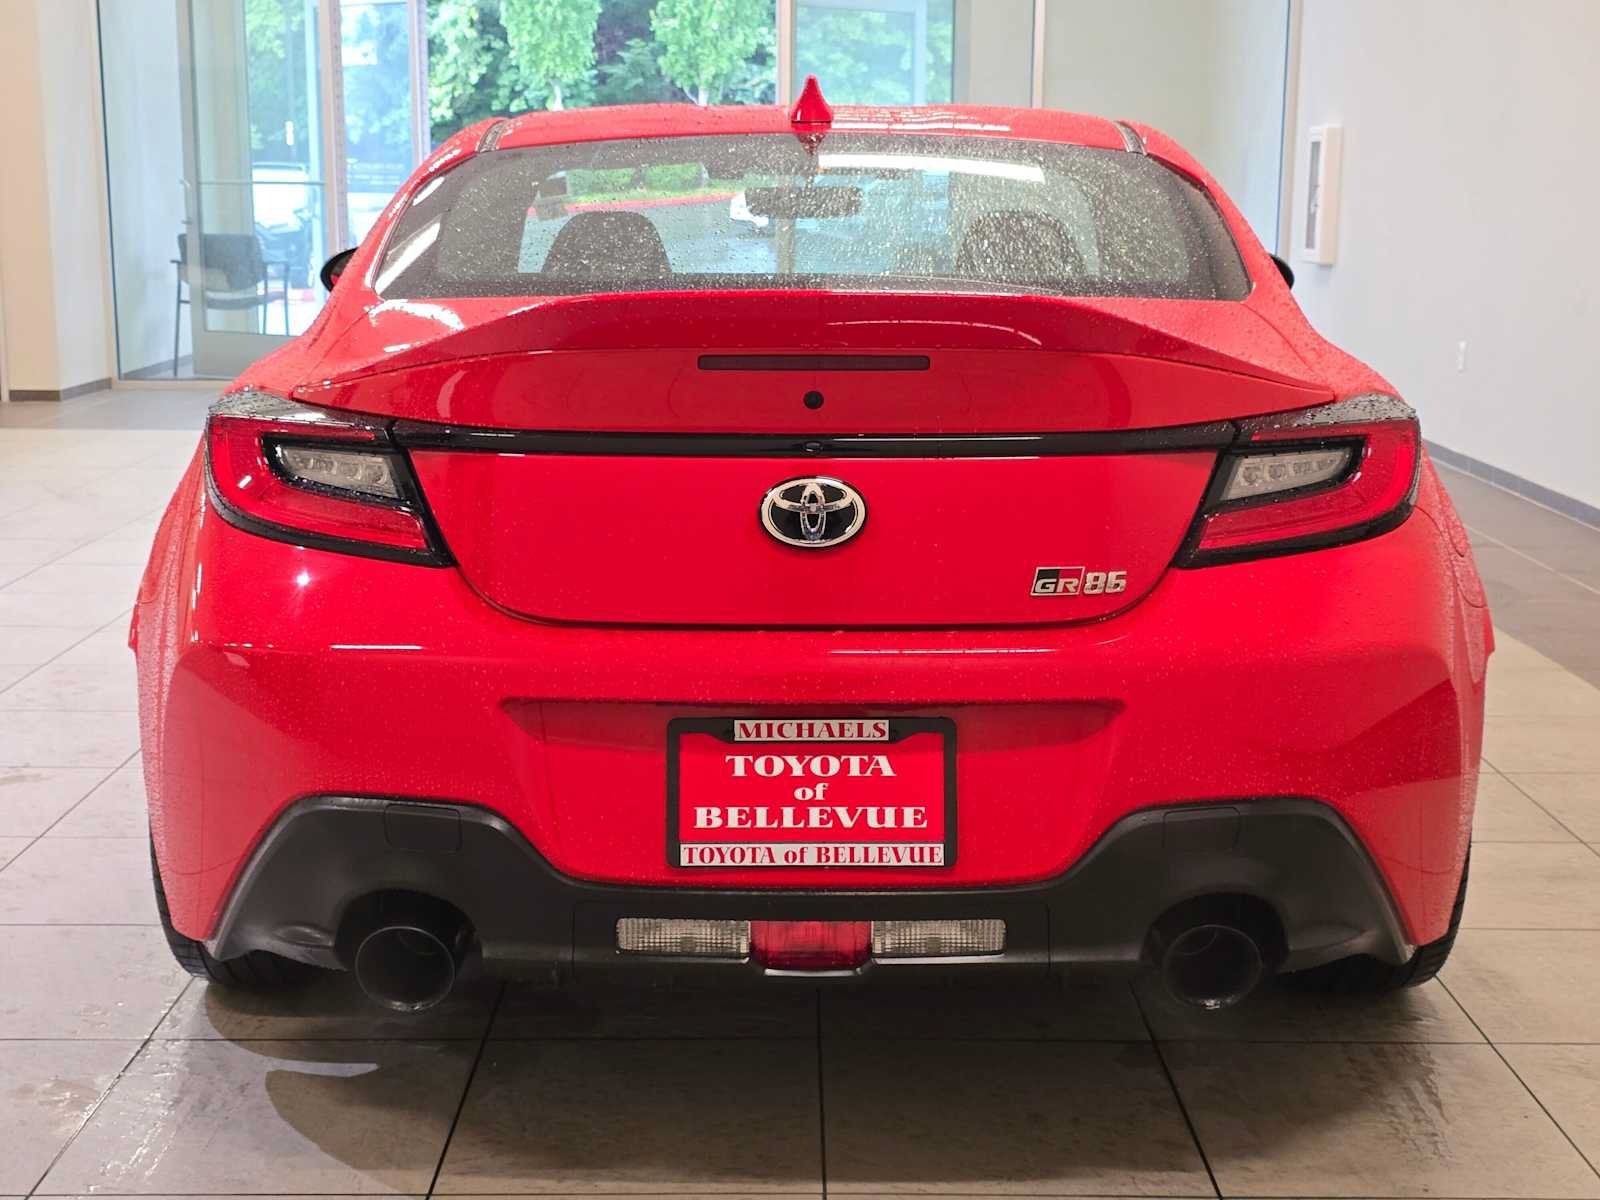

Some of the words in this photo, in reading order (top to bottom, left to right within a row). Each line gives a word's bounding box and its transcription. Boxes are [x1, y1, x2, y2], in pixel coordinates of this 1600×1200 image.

[1035, 578, 1079, 593] GR
[1083, 571, 1127, 594] 86
[738, 722, 887, 738] MICHAELS
[725, 755, 896, 777] TOYOTA
[793, 783, 828, 801] of
[694, 806, 928, 828] BELLEVUE
[683, 847, 776, 864] TOYOTA
[784, 847, 808, 864] of
[815, 847, 943, 864] BELLEVUE
